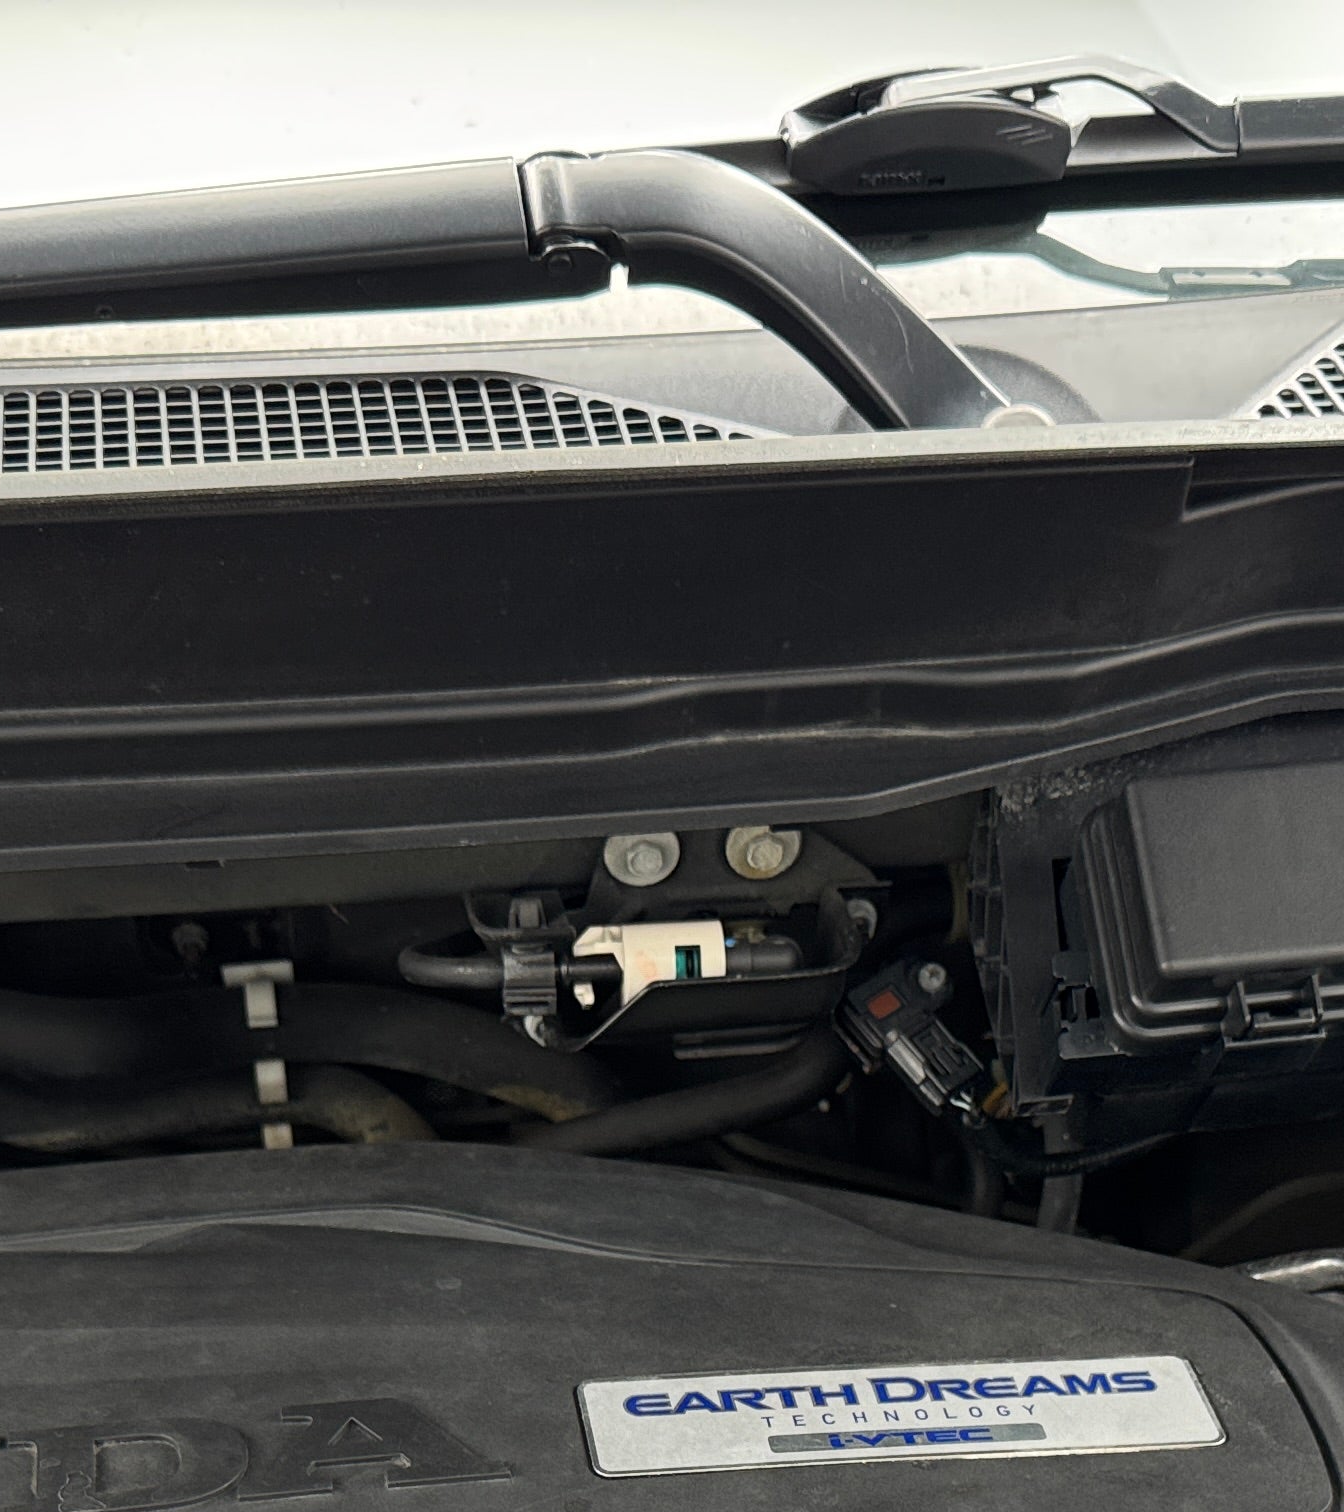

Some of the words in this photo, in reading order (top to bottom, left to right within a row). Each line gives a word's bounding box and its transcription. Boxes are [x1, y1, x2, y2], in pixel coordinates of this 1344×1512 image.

[623, 1383, 859, 1417] EARTH
[866, 1371, 1157, 1404] DREAMS
[761, 1404, 1035, 1428] TECHNOLOGY
[828, 1427, 993, 1449] i-VTEC
